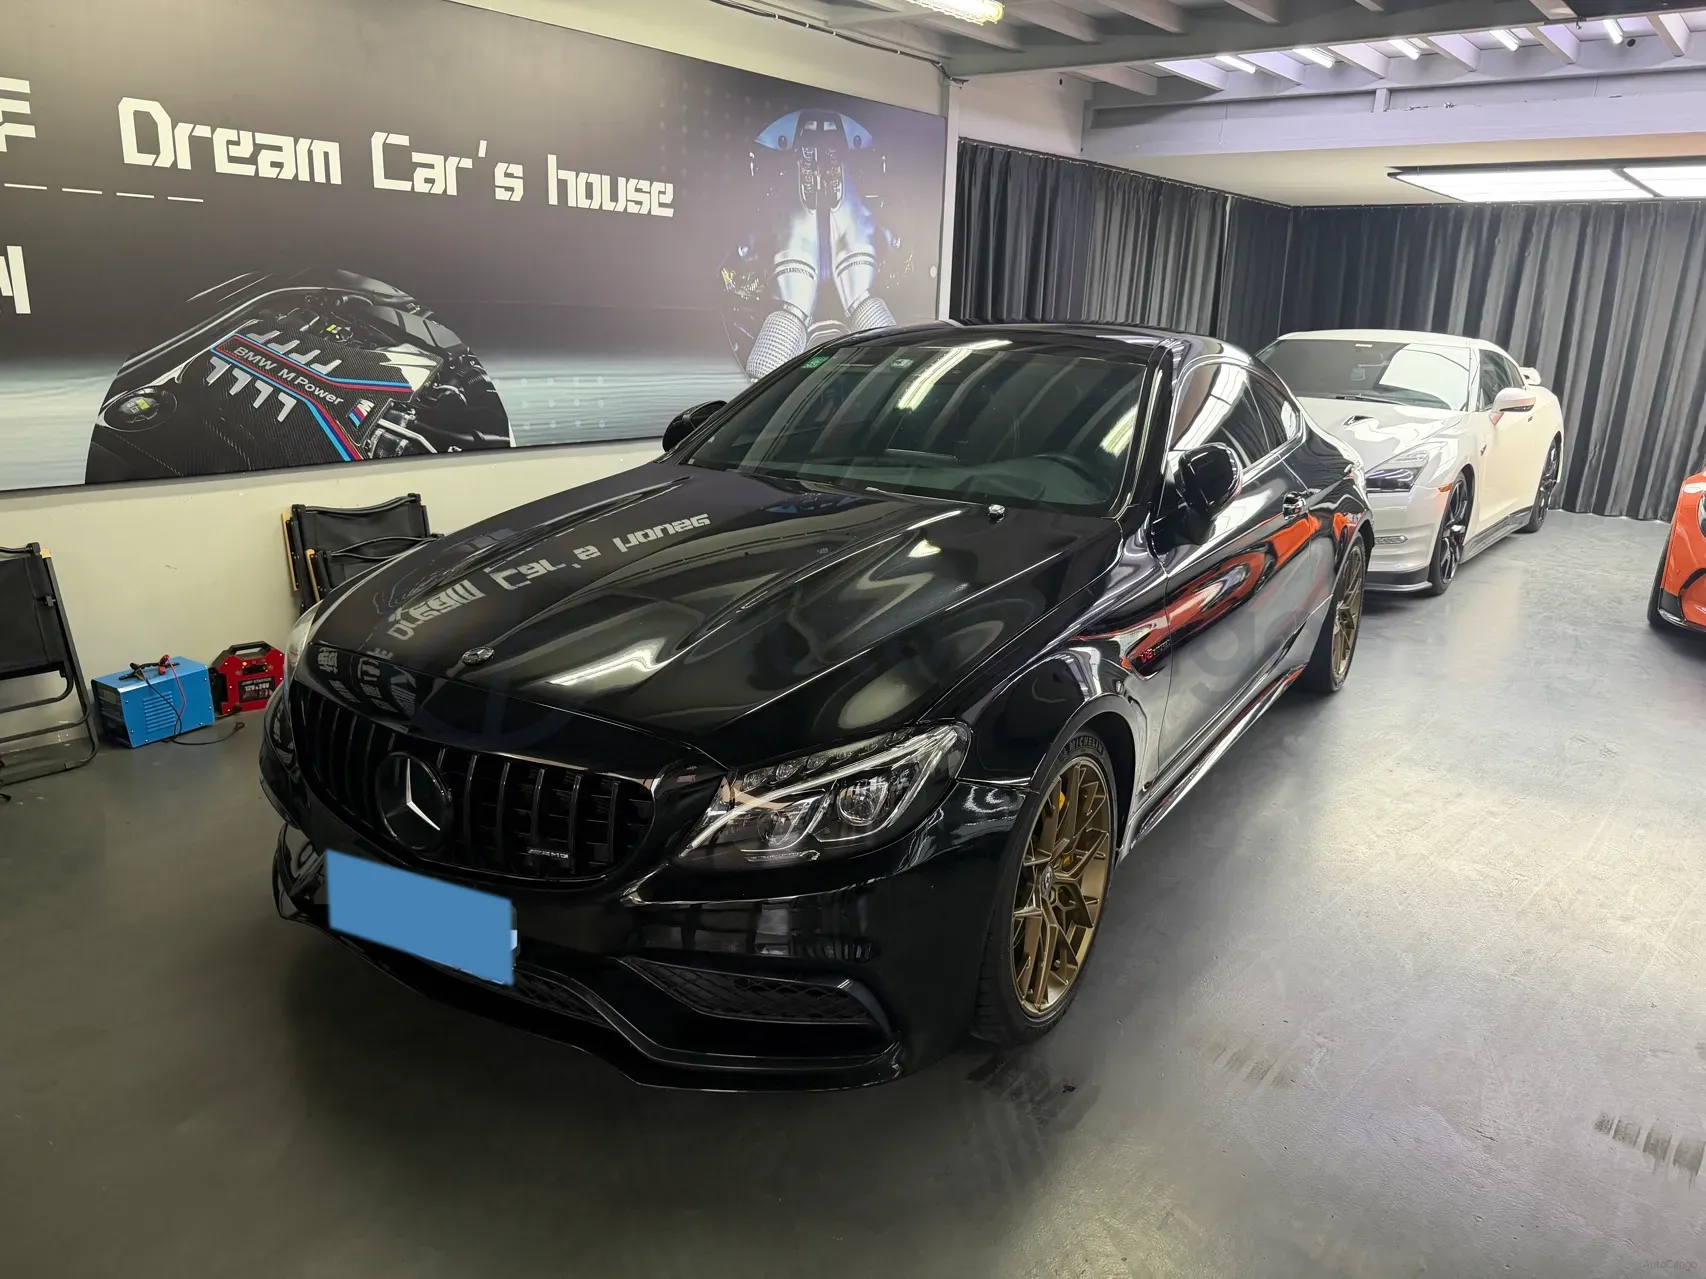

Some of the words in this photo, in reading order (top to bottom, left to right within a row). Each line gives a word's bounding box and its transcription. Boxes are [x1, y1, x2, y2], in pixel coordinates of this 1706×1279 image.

[117, 97, 342, 186] Dream
[371, 131, 524, 202] Car's
[548, 154, 674, 218] house
[233, 346, 278, 371] BMW
[293, 377, 344, 405] Power
[1069, 736, 1104, 755] MICHELIN
